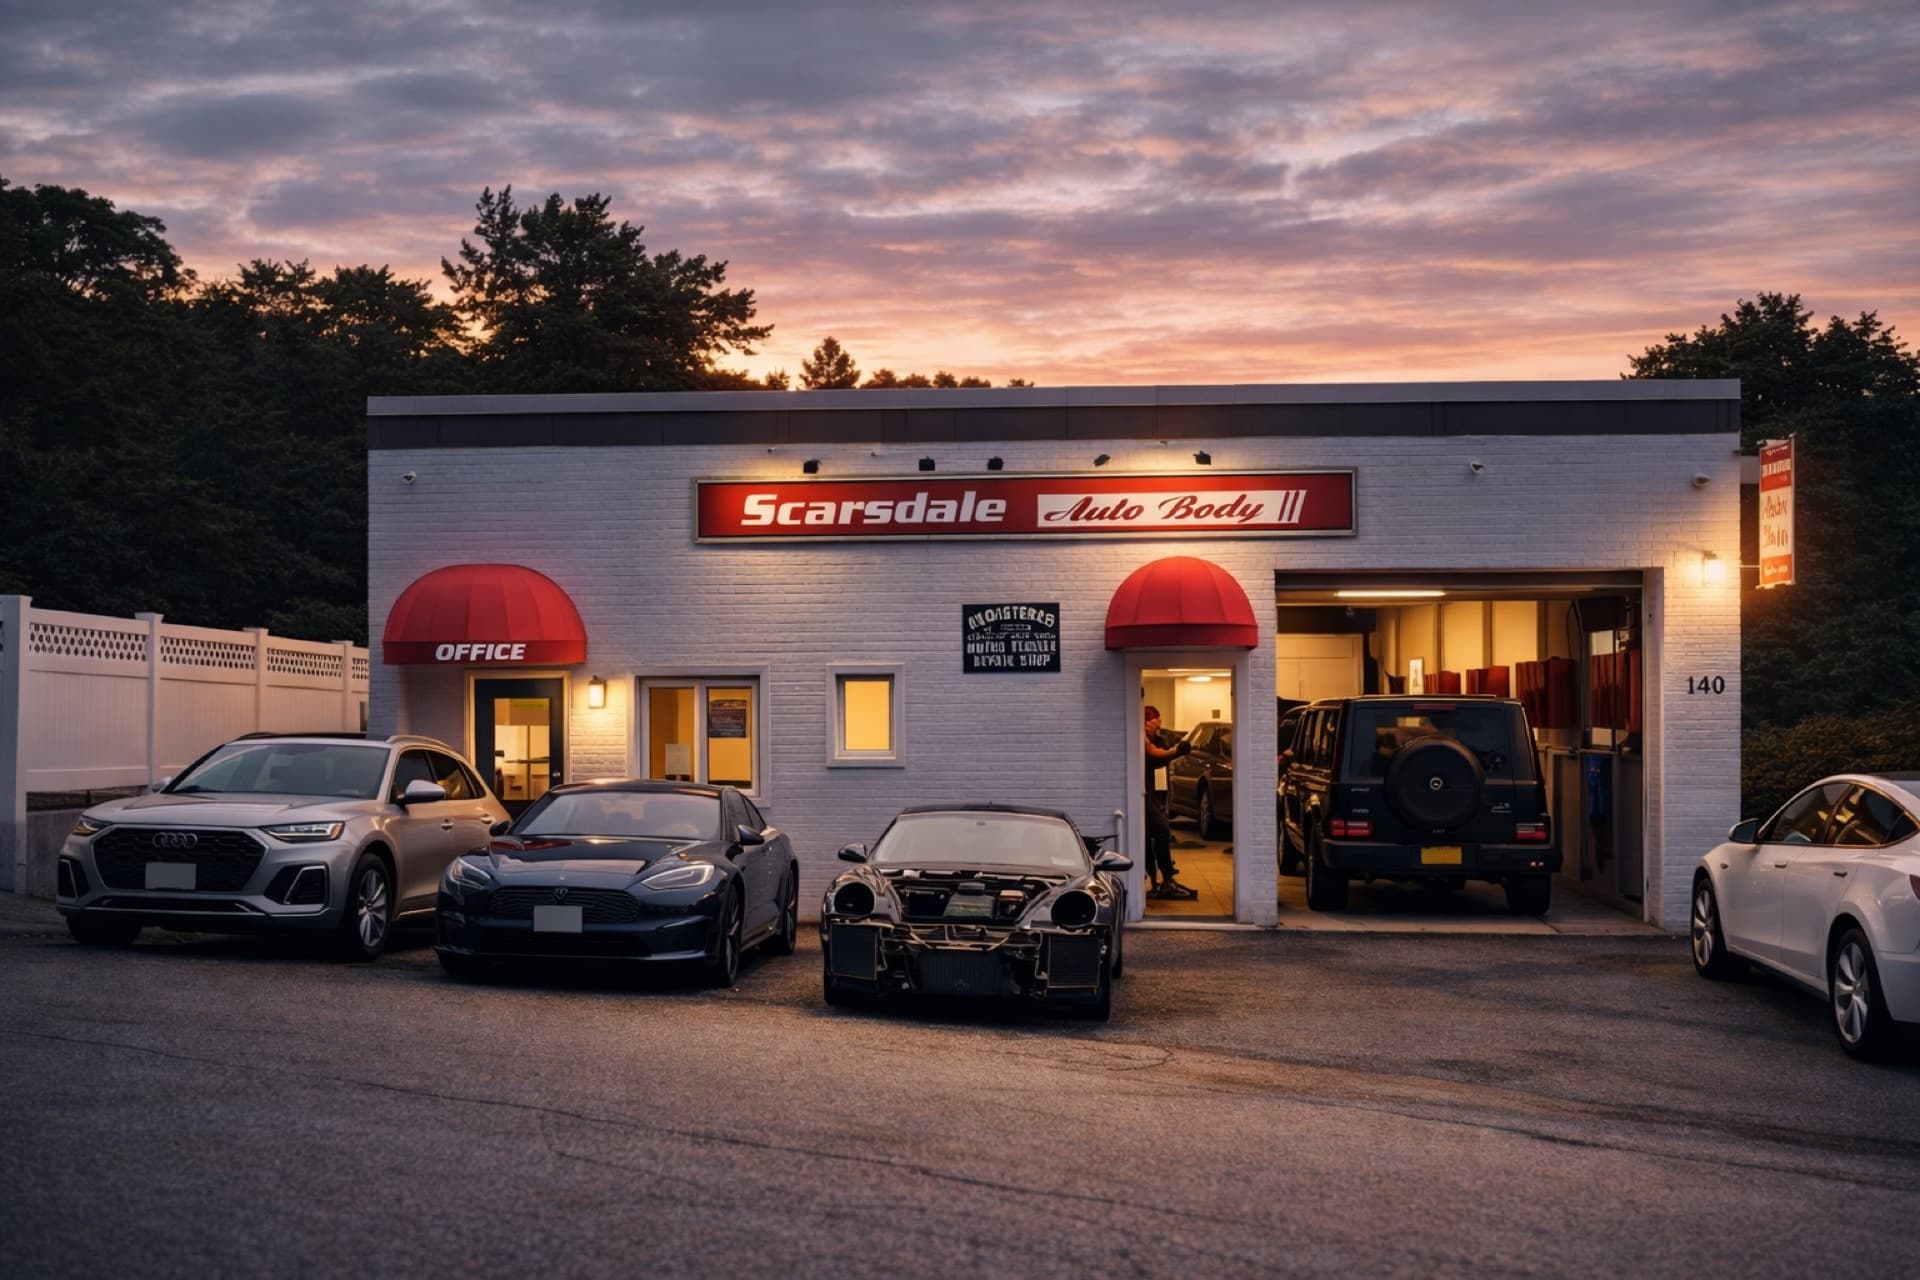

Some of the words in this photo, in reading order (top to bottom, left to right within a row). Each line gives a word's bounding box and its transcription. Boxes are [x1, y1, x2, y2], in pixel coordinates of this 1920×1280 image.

[741, 490, 1007, 526] Scarsdale
[1043, 495, 1144, 522] Auto
[1158, 493, 1265, 523] Body
[435, 643, 526, 661] OFFICE
[1686, 675, 1726, 695] 140
